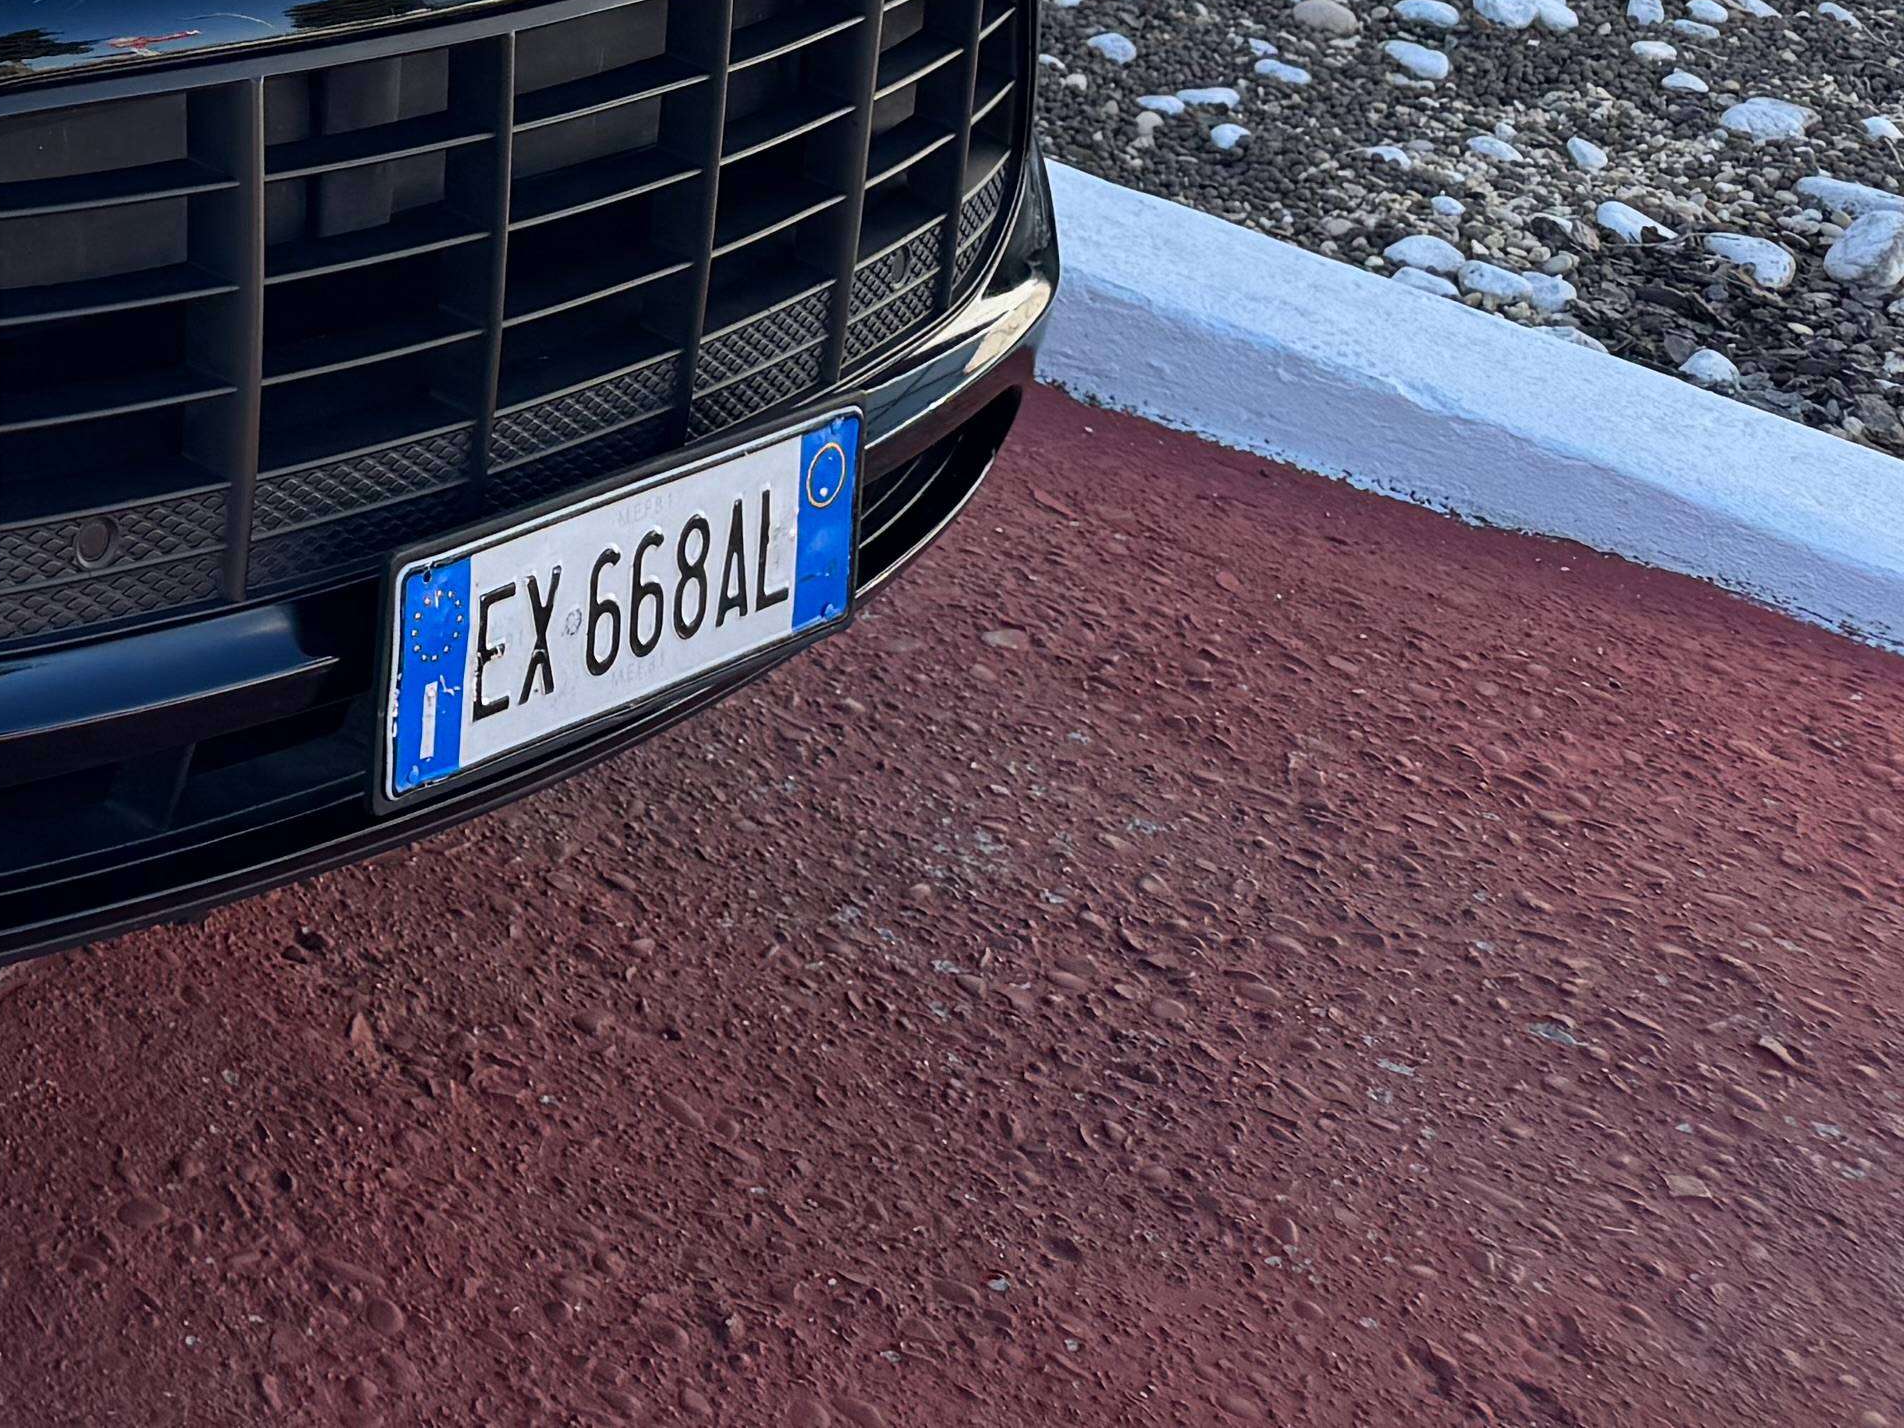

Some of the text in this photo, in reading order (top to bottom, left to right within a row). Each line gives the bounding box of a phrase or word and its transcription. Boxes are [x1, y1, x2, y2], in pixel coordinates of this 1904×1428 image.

[472, 490, 790, 723] EX 668AL
[420, 681, 439, 760] I
